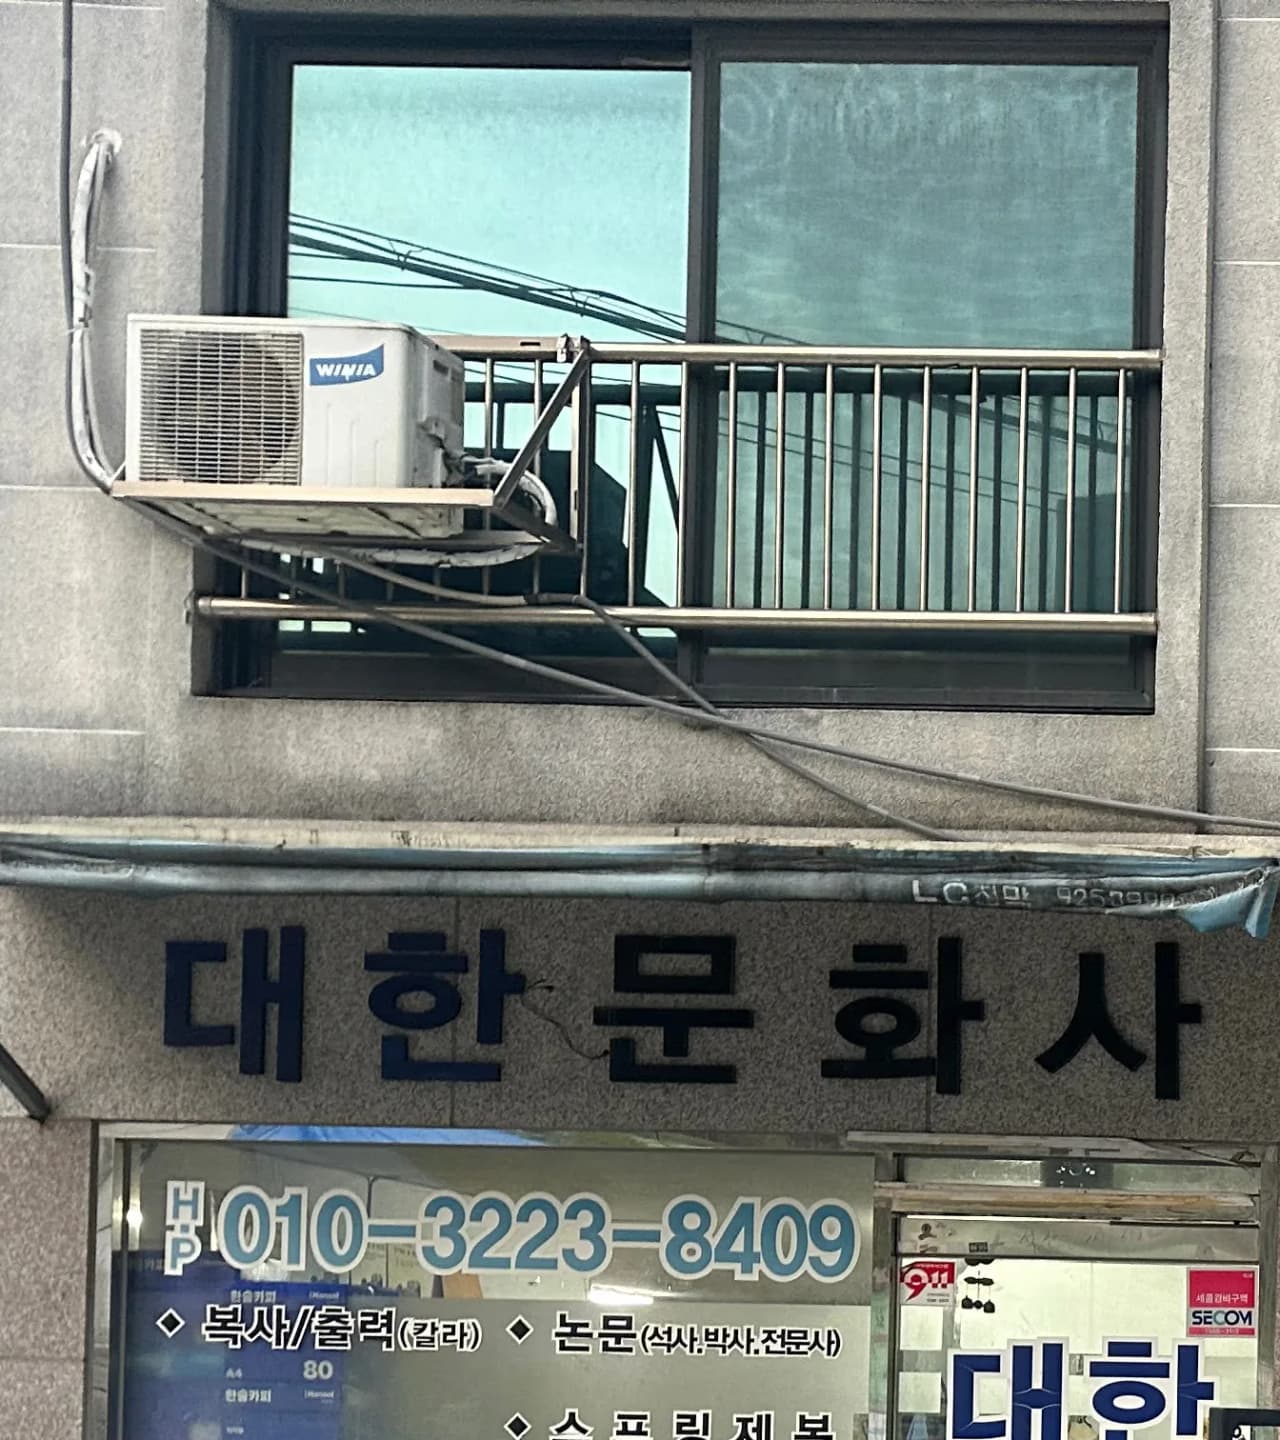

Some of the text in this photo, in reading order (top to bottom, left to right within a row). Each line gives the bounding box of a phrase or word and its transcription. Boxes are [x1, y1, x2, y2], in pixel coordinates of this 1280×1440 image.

[315, 363, 376, 381] WINIA
[164, 924, 1202, 1101] 대한문화사
[216, 1186, 862, 1281] 010-3223-8409
[1192, 1310, 1252, 1326] SECOM
[303, 1360, 334, 1380] 80
